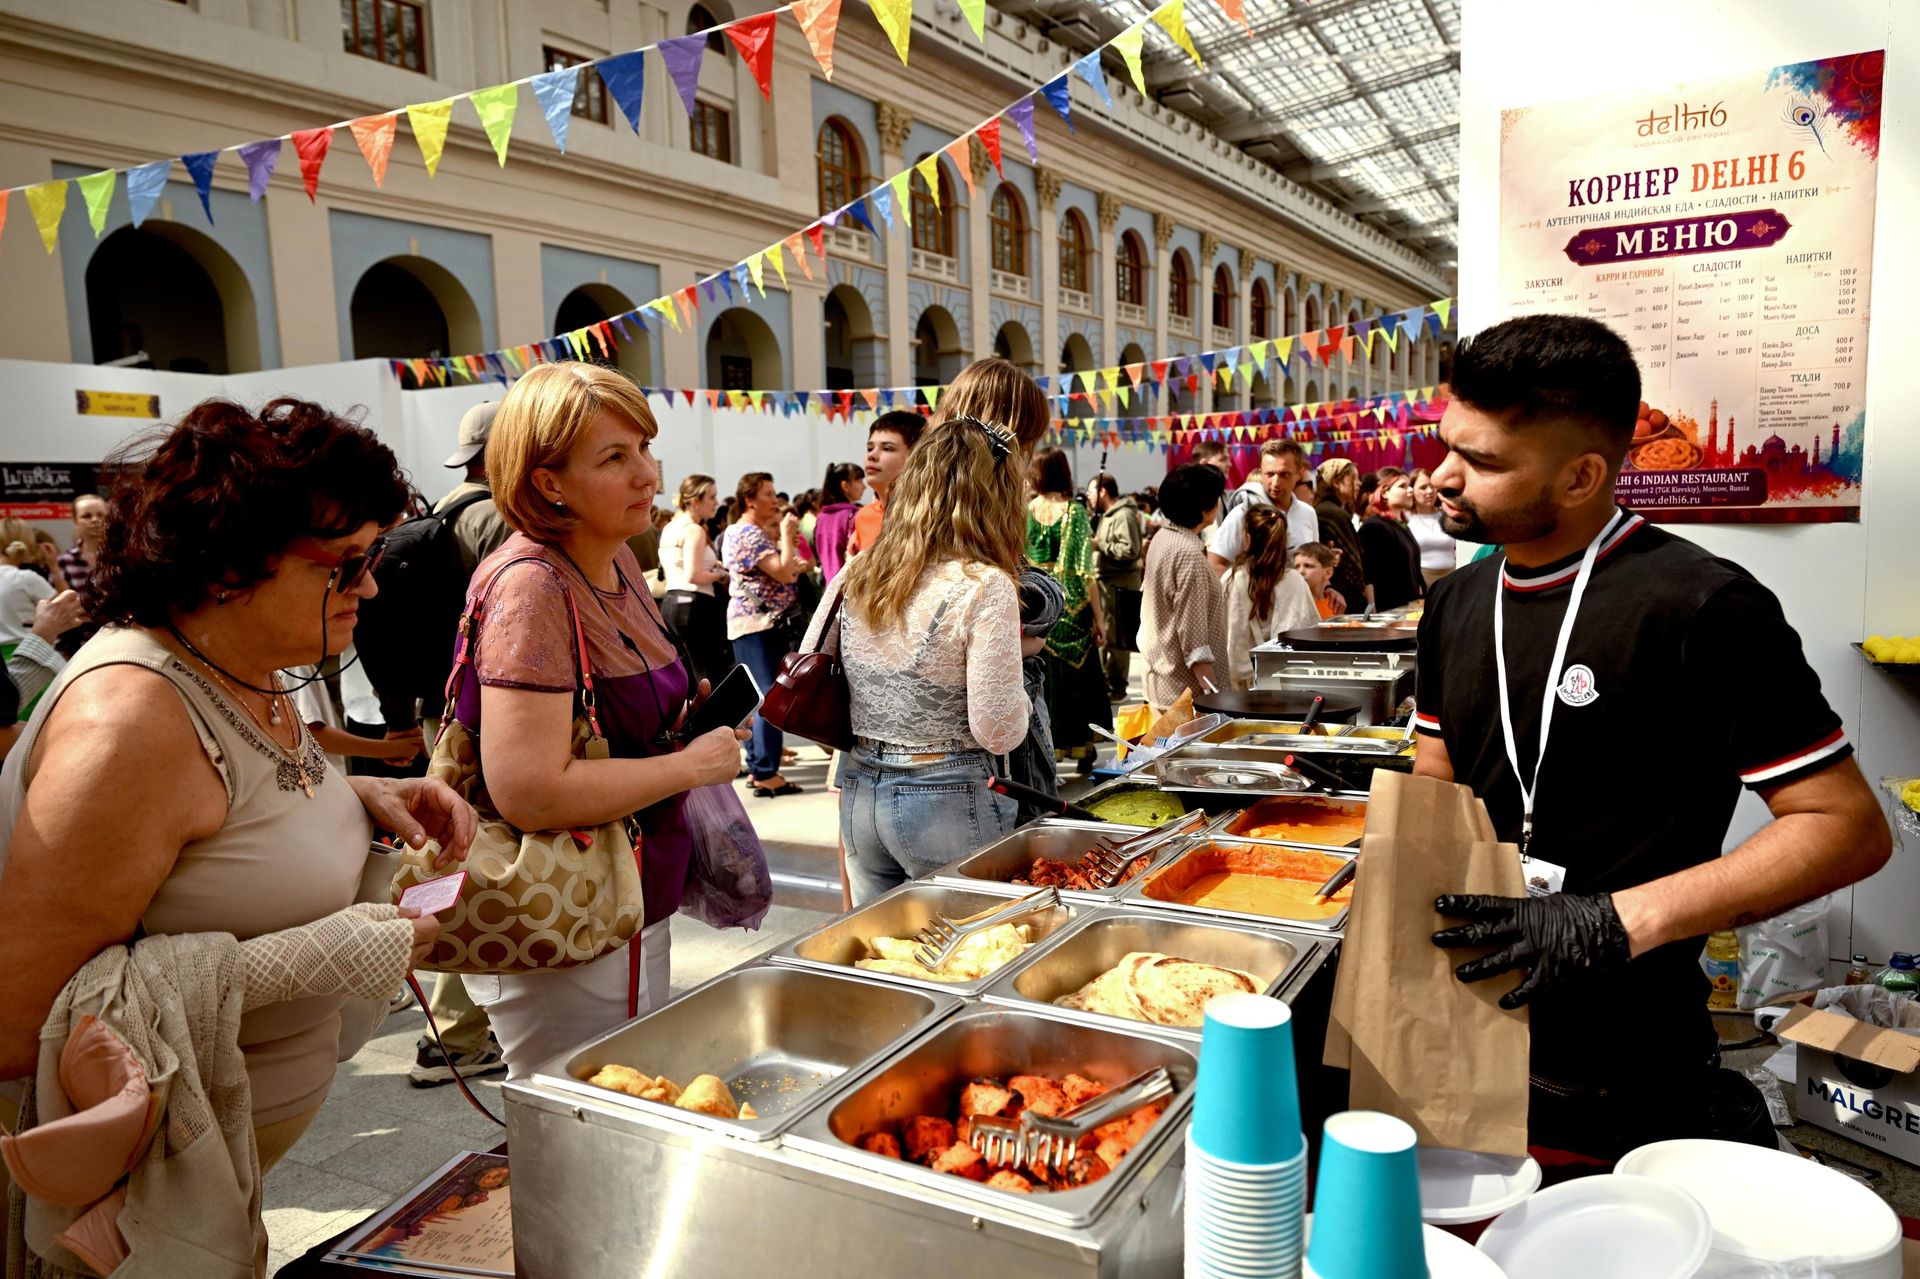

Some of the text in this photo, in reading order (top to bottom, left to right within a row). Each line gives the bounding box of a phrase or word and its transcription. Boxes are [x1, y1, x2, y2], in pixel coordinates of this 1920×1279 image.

[1686, 131, 1730, 142] ресторан
[1568, 150, 1806, 208] КОРНЕР DELHI 6
[1546, 187, 1818, 228] АУТЕНТИЧНАЯ ИНДИЙСКАЯ ЕДА СЛАДОСТИ НАПИТКИ
[1615, 219, 1738, 257] МЕНЮ
[1786, 251, 1832, 264] НАПИТКИ
[1693, 260, 1742, 272] СЛАДОСТИ
[1596, 268, 1664, 282] КАРРИ И ГАРНИРЫ
[1524, 276, 1563, 290] ЗАКУСКИ
[1738, 278, 1750, 286] 100
[1652, 286, 1664, 294] 200
[1738, 294, 1749, 302] 100
[1737, 312, 1748, 320] 100
[1796, 326, 1820, 336] ДОСА
[1650, 344, 1661, 352] 200
[1736, 347, 1746, 355] 100
[1791, 373, 1821, 383] ТХАЛИ
[1616, 472, 1749, 486] LHI 6 INDIAN RESTAURANT
[1655, 486, 1670, 494] (TGK
[1672, 486, 1702, 494] Kievskiy),
[1703, 485, 1728, 493] Moscow,
[1632, 495, 1700, 506] www.delhi6.ru
[1864, 1129, 1887, 1144] WATER
